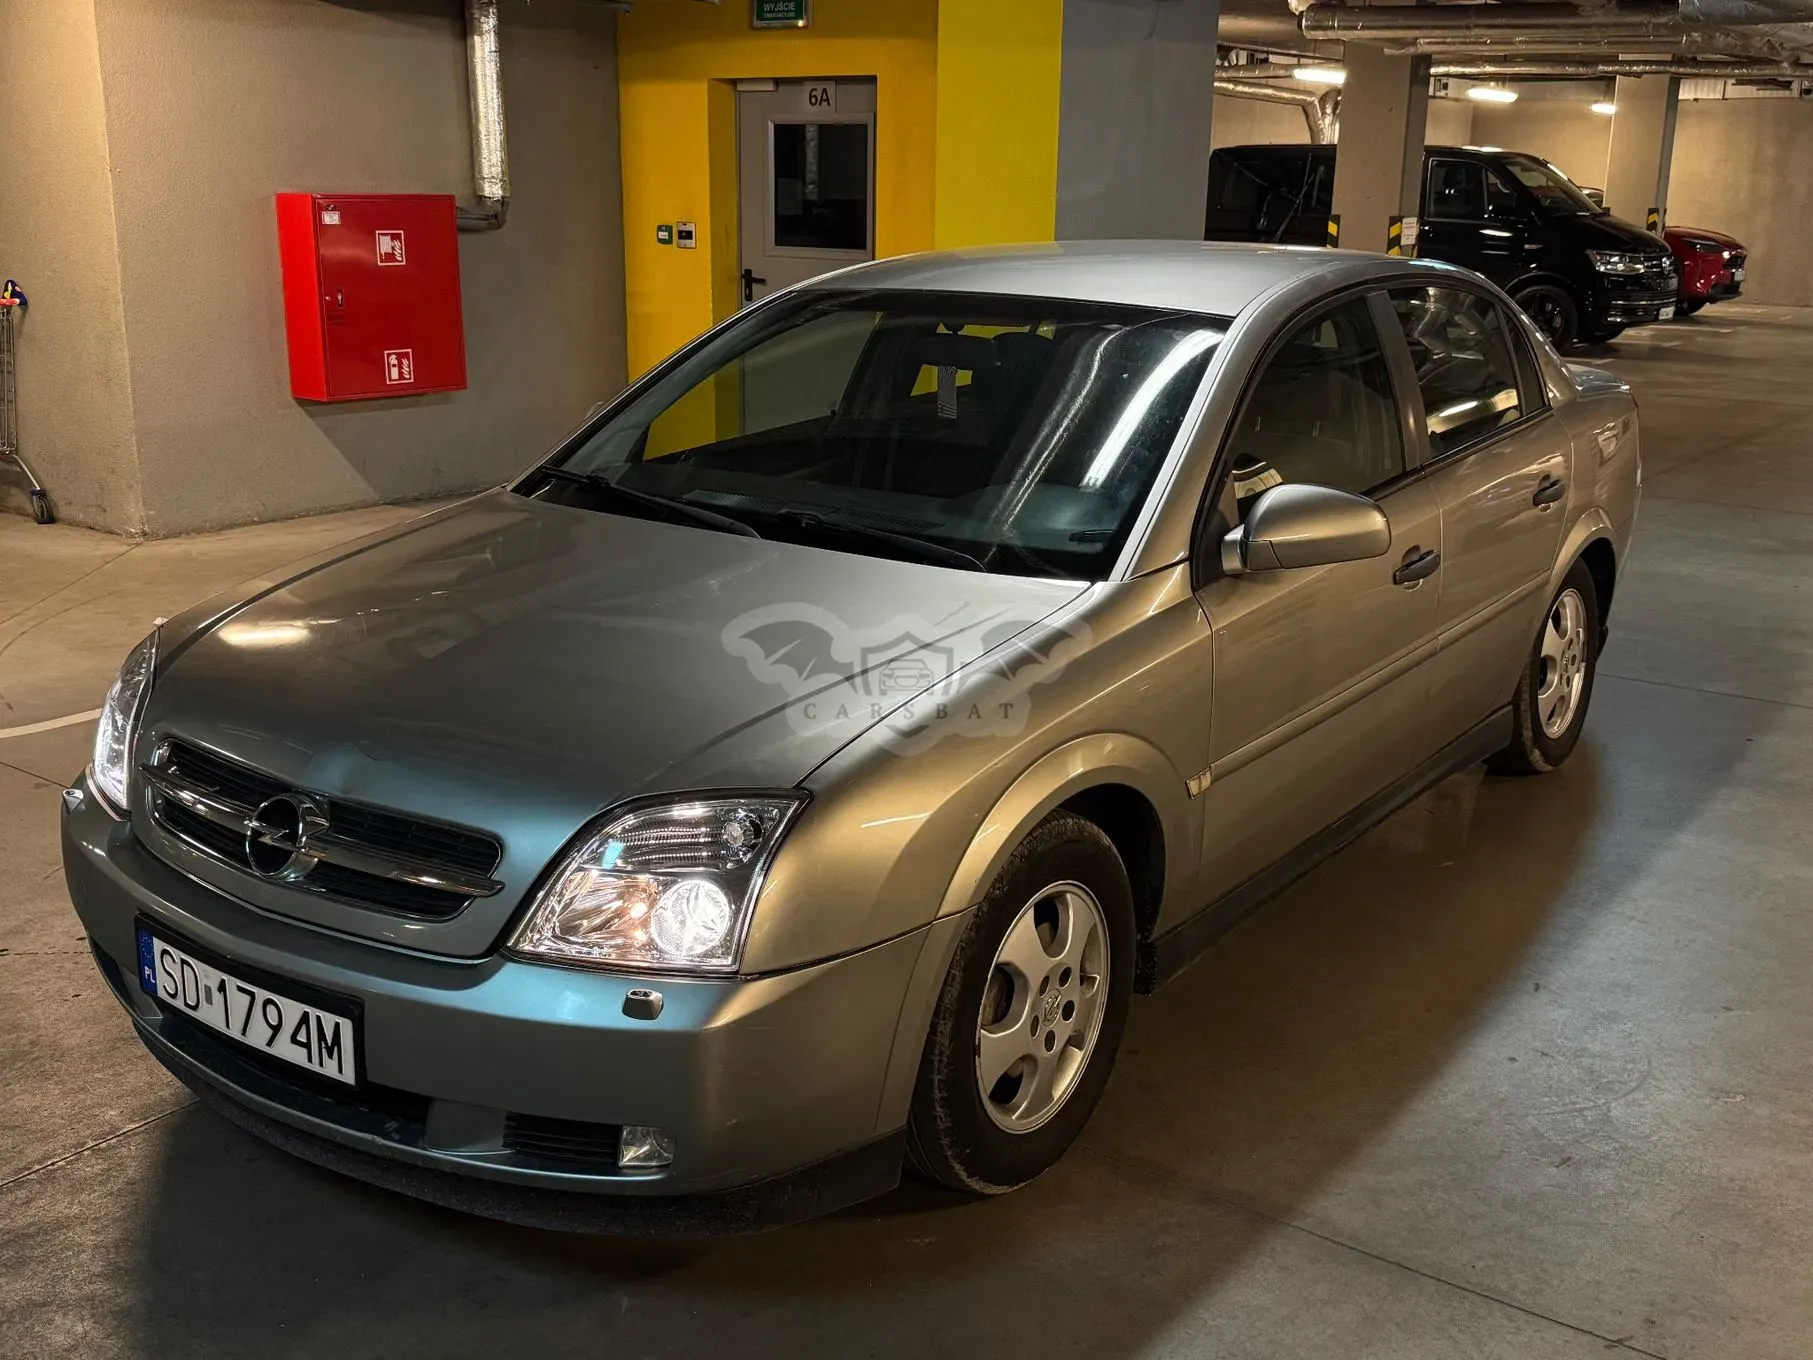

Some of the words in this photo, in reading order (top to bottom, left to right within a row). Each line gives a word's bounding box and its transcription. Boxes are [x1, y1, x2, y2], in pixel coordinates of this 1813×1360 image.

[763, 1, 796, 11] WYJŚCIE
[808, 87, 831, 107] 6A
[144, 965, 156, 984] PL
[160, 947, 201, 1012] SD
[217, 975, 345, 1075] 1794M
